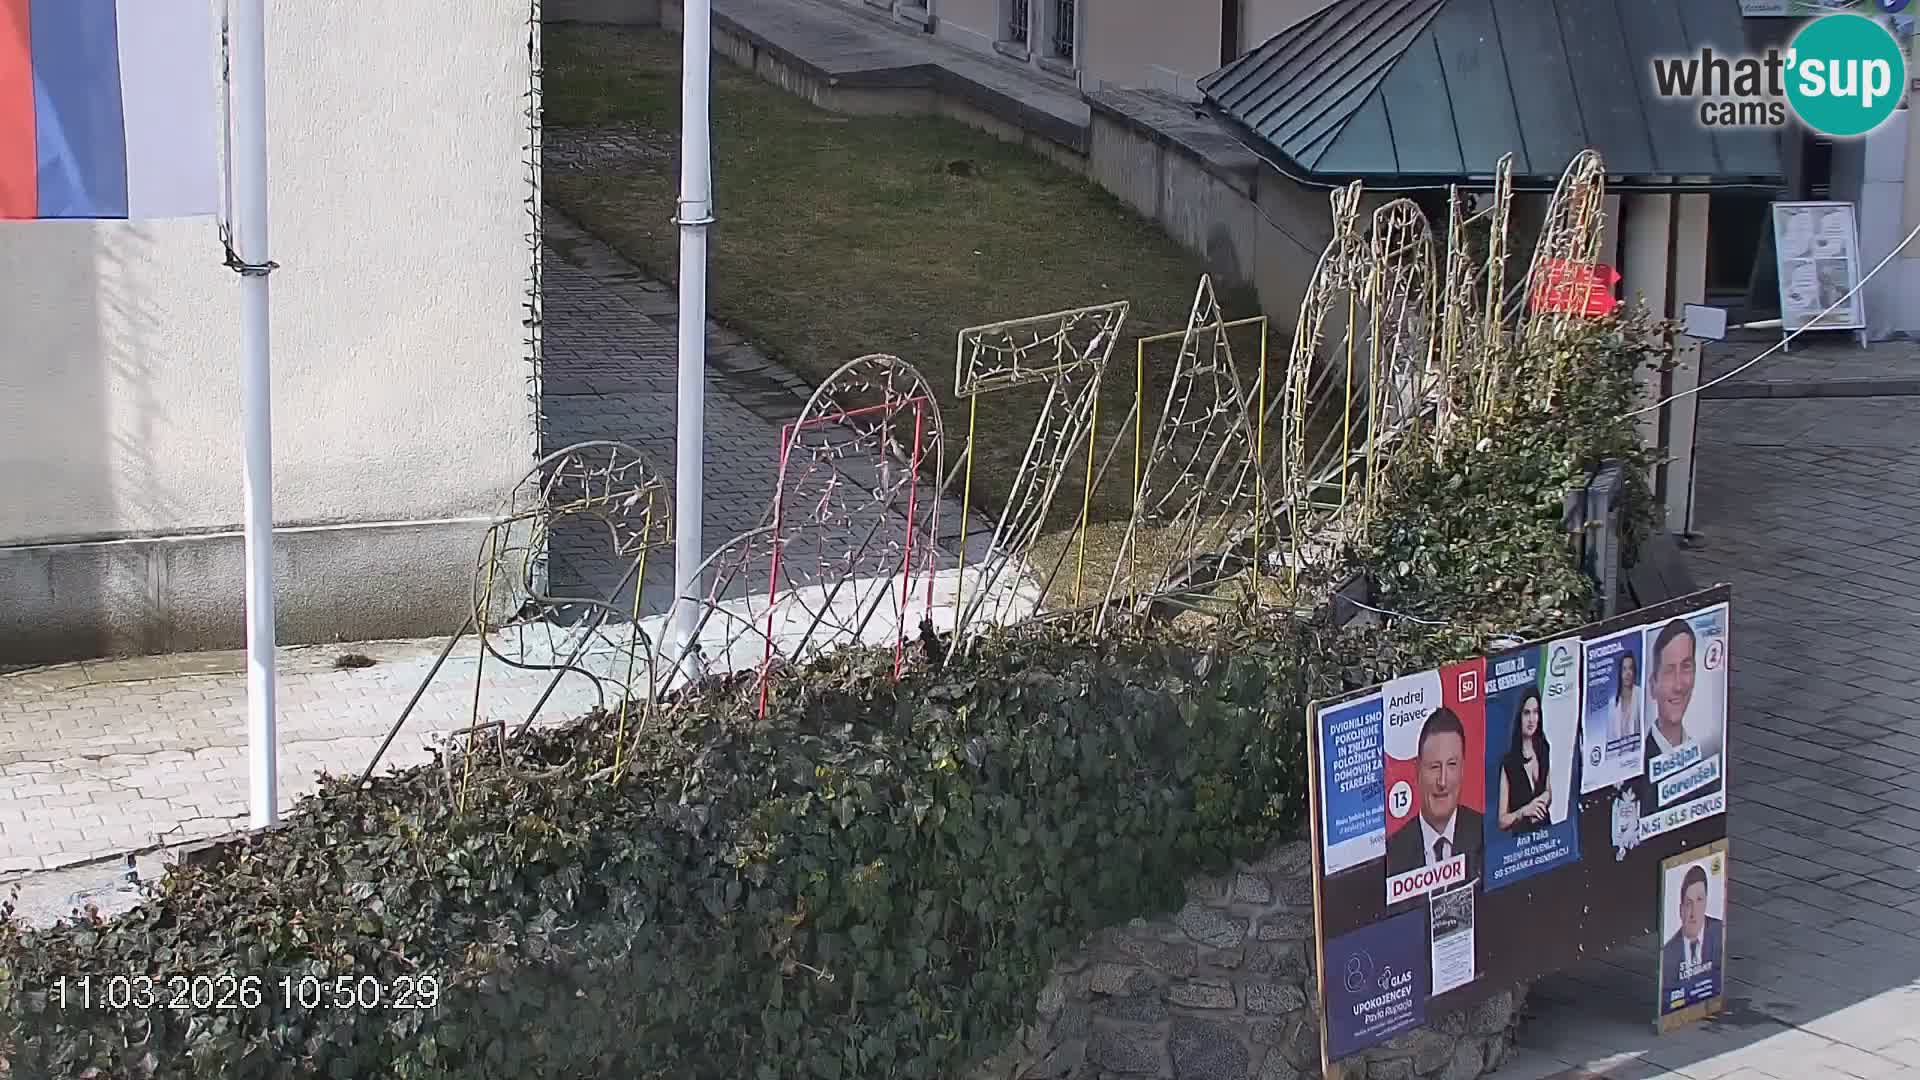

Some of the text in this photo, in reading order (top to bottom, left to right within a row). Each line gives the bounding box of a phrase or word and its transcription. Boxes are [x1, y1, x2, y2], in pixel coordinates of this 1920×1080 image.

[1462, 681, 1473, 693] SD
[1389, 688, 1424, 710] Andrej
[1389, 708, 1427, 727] Erjavec
[1393, 790, 1408, 809] 13
[1690, 797, 1722, 818] FOKUS
[1393, 861, 1461, 897] DOGOVOR
[1390, 970, 1412, 987] GLAS
[1353, 984, 1412, 1016] UPOKOJENCEV
